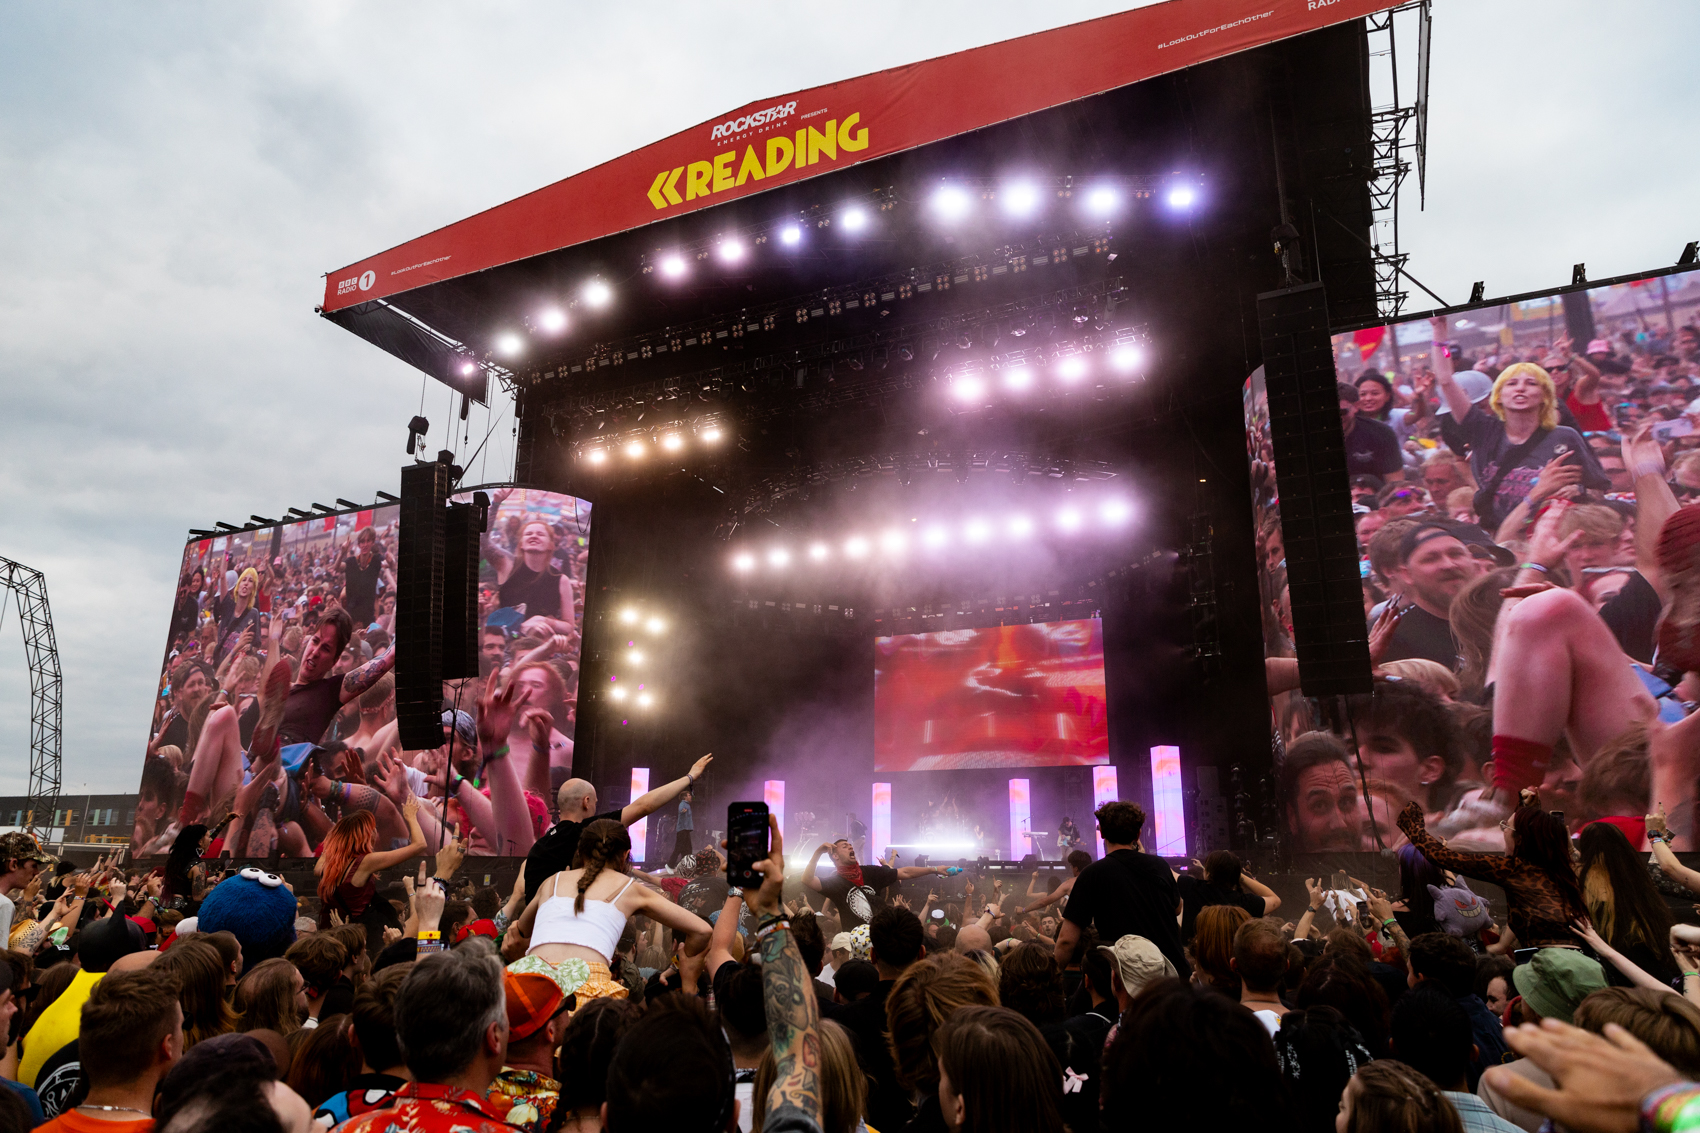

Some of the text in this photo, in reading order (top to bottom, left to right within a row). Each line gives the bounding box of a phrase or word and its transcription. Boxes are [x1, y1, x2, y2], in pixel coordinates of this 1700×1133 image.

[1157, 10, 1275, 49] #LookOutForEachOther
[710, 101, 797, 140] ROCKSTAR
[800, 107, 828, 120] PRESENTS
[717, 120, 788, 147] ENERGY DRINK
[686, 112, 869, 201] READING
[337, 284, 357, 295] RADIO
[338, 276, 358, 289] BBC
